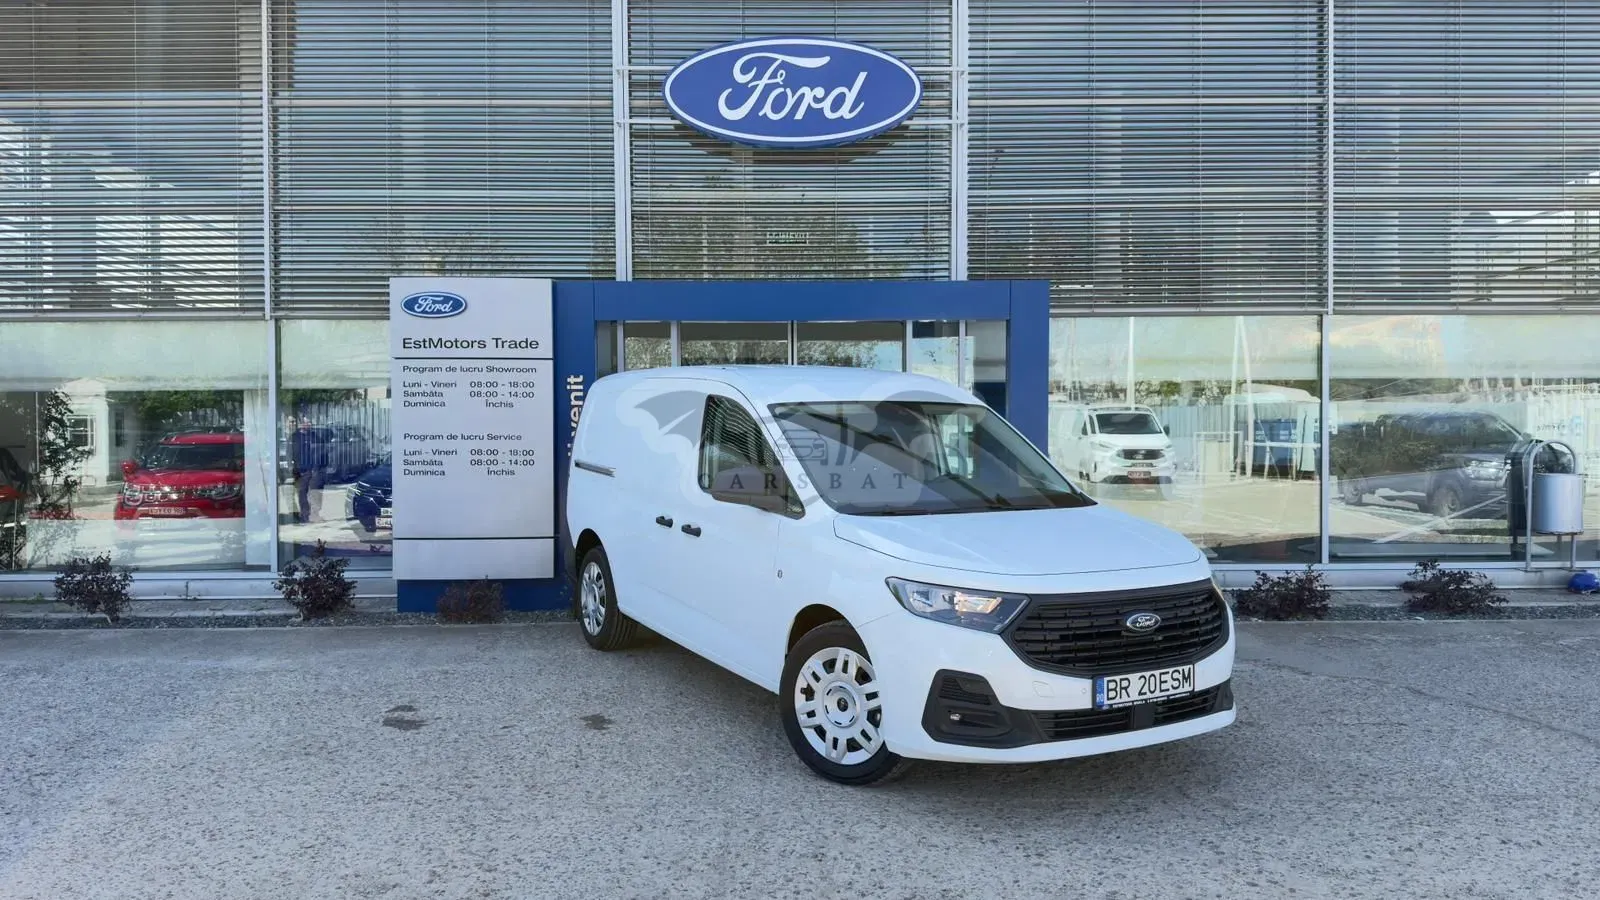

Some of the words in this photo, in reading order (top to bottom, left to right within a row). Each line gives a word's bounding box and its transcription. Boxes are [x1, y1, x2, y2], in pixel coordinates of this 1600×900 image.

[718, 52, 868, 121] Ford
[414, 296, 453, 312] Ford
[402, 338, 487, 349] EstMotors
[492, 338, 539, 349] Trade
[402, 365, 443, 374] Program
[445, 365, 457, 373] de
[469, 381, 499, 389] 08:00
[469, 390, 499, 398] 08:00
[509, 391, 535, 399] 14:00
[403, 400, 446, 408] Duminica
[485, 399, 514, 408] Închis
[403, 433, 444, 441] Program
[446, 433, 459, 441] de
[509, 449, 535, 457] 18:00
[403, 468, 446, 476] Duminica
[487, 467, 516, 476] Închis
[1136, 616, 1156, 627] Ford
[1106, 677, 1132, 701] BR
[1137, 667, 1192, 697] 20ESM
